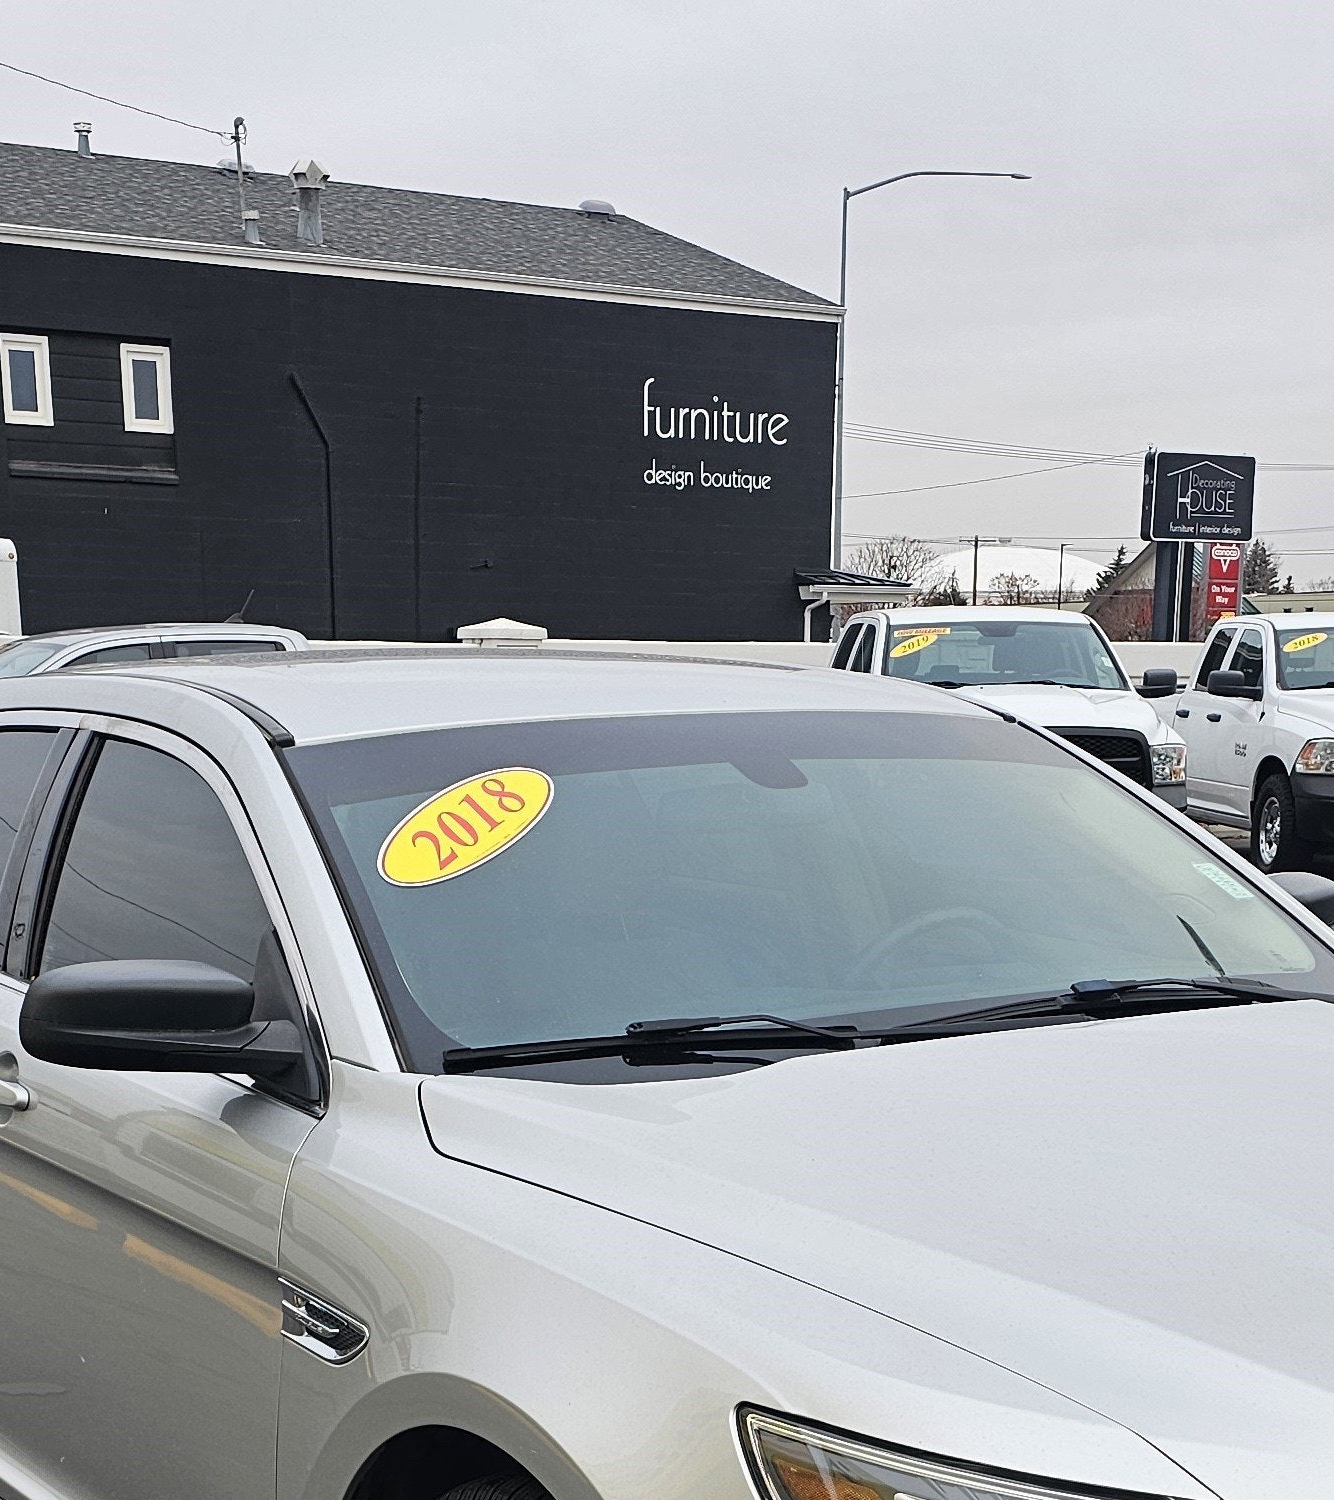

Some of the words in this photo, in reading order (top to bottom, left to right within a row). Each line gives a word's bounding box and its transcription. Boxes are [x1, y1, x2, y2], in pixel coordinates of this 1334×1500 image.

[643, 377, 790, 446] furniture
[643, 458, 694, 491] design
[700, 460, 772, 494] boutique
[1192, 473, 1236, 490] Decorating
[1176, 470, 1235, 519] HOUSE
[1169, 521, 1195, 533] furniture
[1199, 524, 1221, 534] interior
[1221, 523, 1242, 536] design
[900, 635, 929, 653] 2019
[1293, 634, 1319, 649] 2018
[412, 778, 525, 870] 2018
